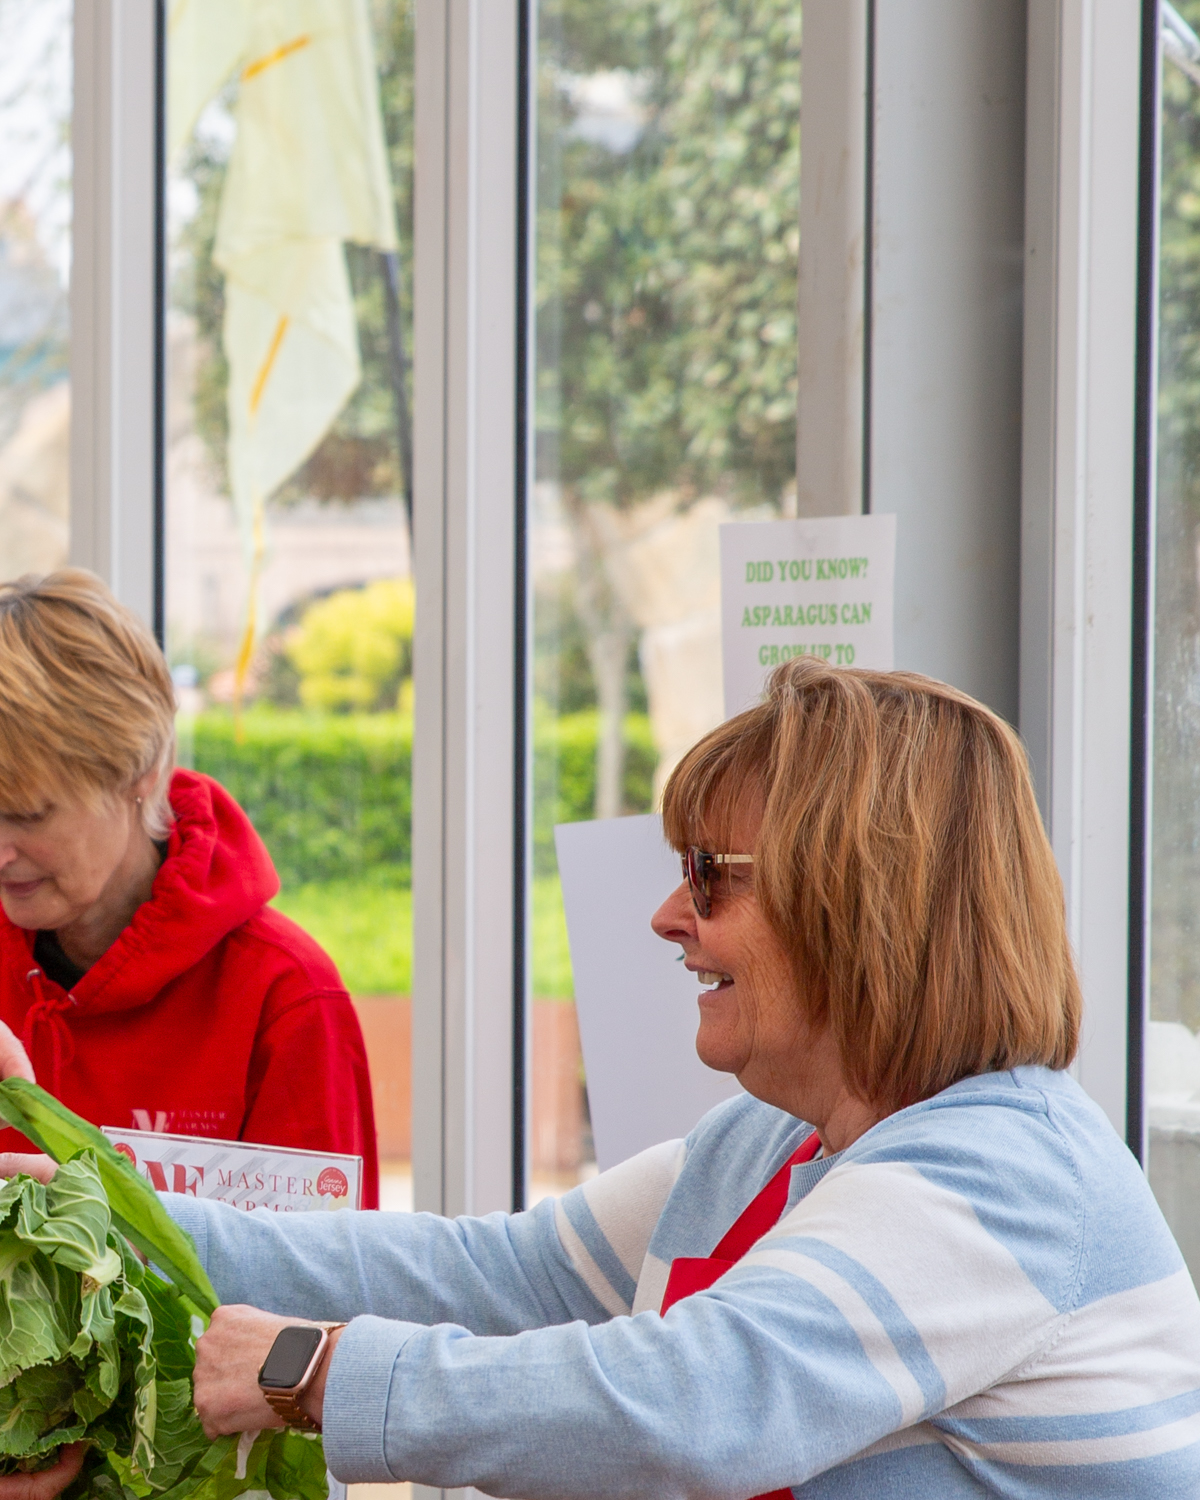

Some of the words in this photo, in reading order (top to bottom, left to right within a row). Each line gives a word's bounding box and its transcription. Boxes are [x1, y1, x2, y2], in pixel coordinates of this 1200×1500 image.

[745, 561, 773, 583] DID
[777, 559, 812, 582] YOU
[816, 557, 869, 580] KNOW?
[741, 604, 838, 627] ASPARAGUS
[841, 602, 872, 625] CAN
[758, 644, 807, 665] GROW
[835, 643, 855, 665] TO
[217, 1168, 315, 1197] MASTER
[320, 1181, 346, 1194] Jersey
